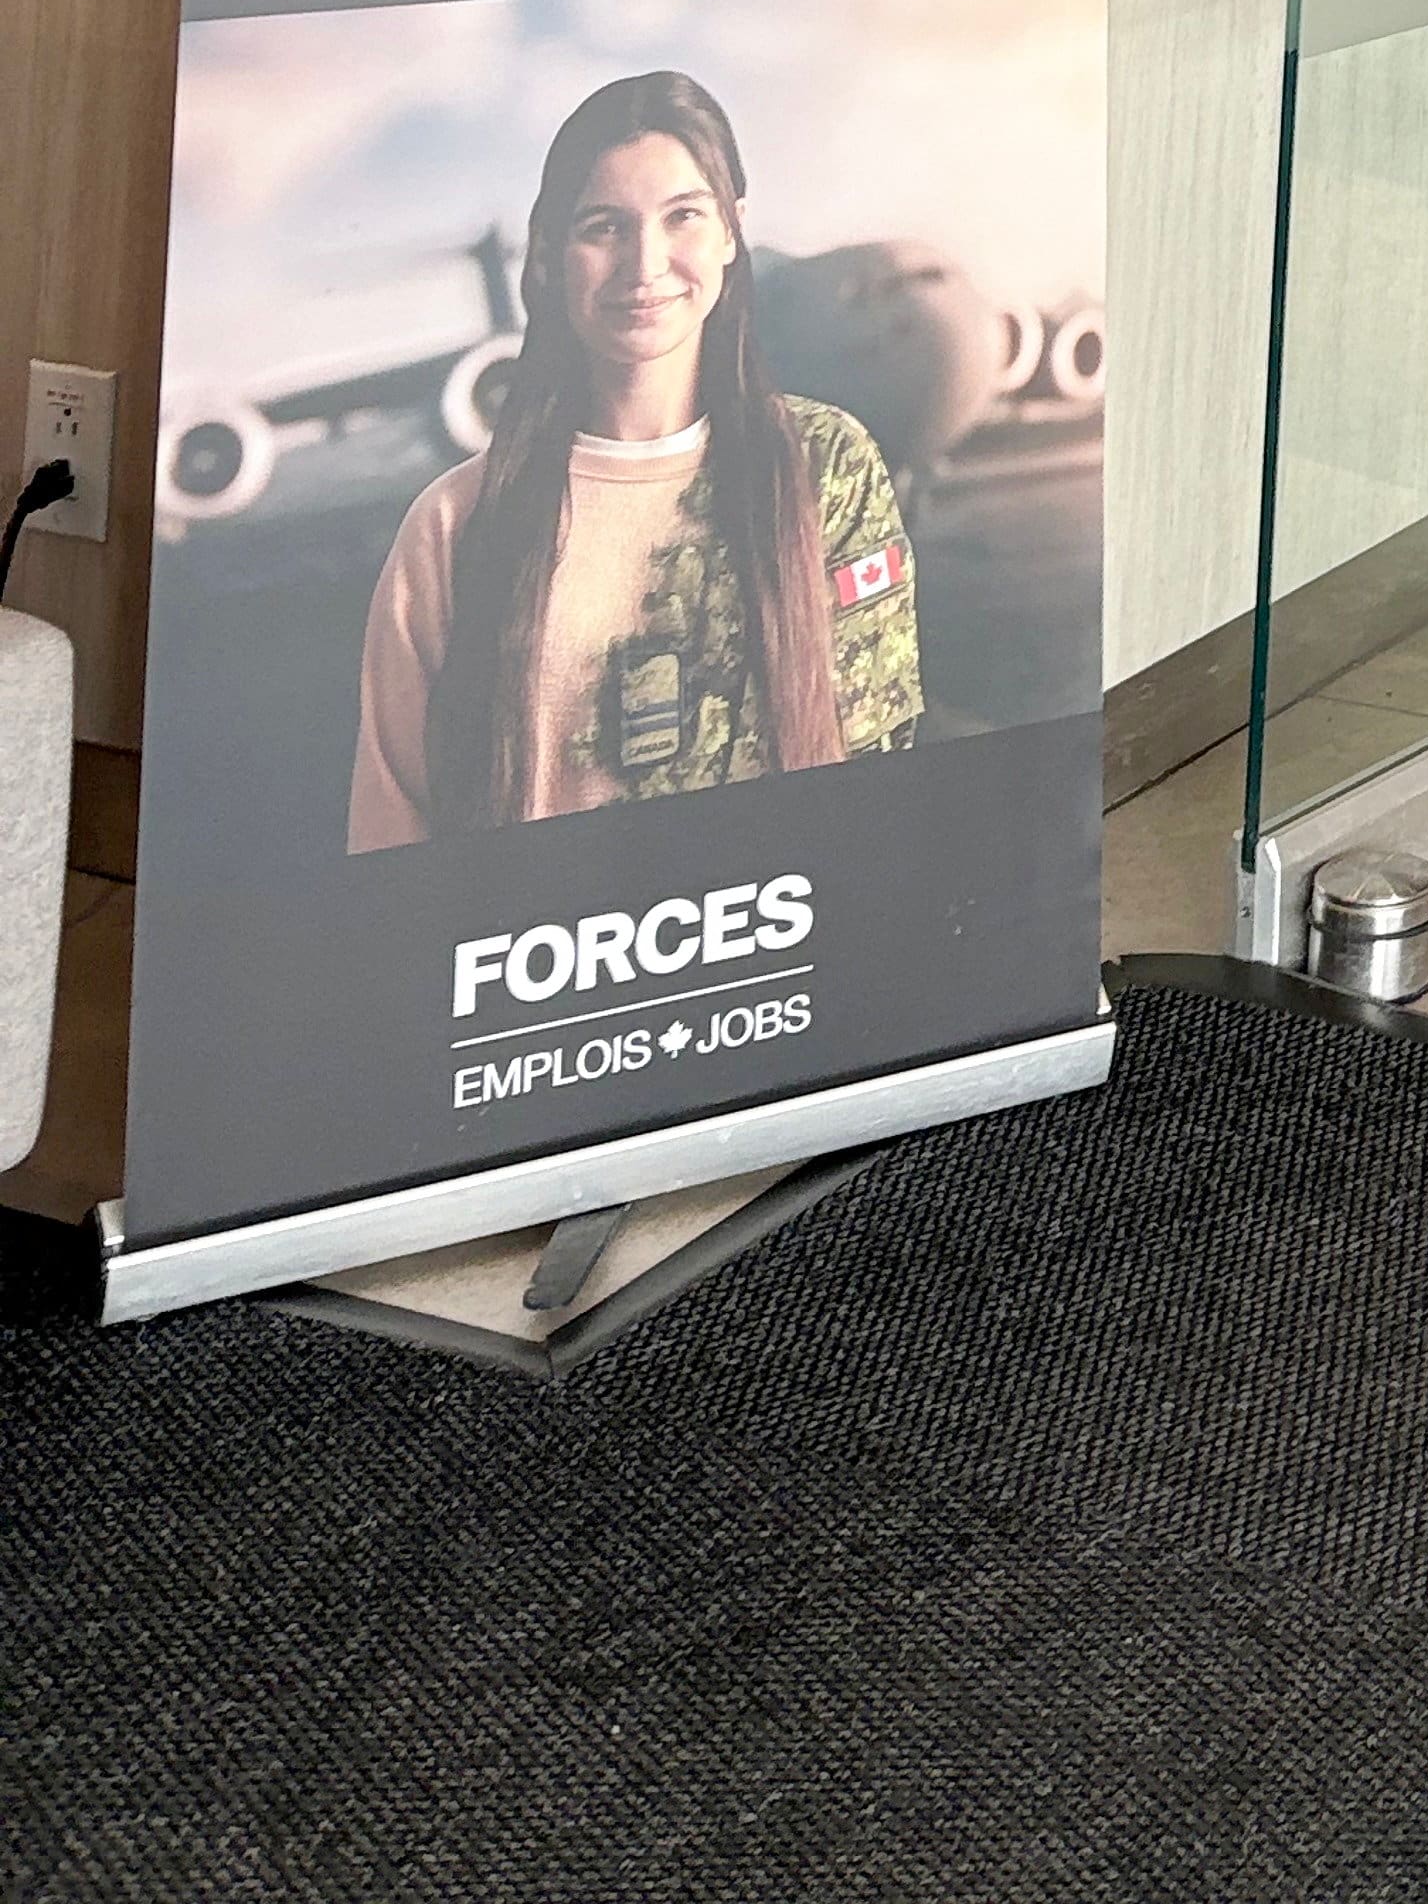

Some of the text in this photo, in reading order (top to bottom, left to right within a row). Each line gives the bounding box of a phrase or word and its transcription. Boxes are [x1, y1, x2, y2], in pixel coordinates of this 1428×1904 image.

[452, 874, 814, 1017] FORCES
[453, 994, 812, 1108] EMPLOIS JOBS
